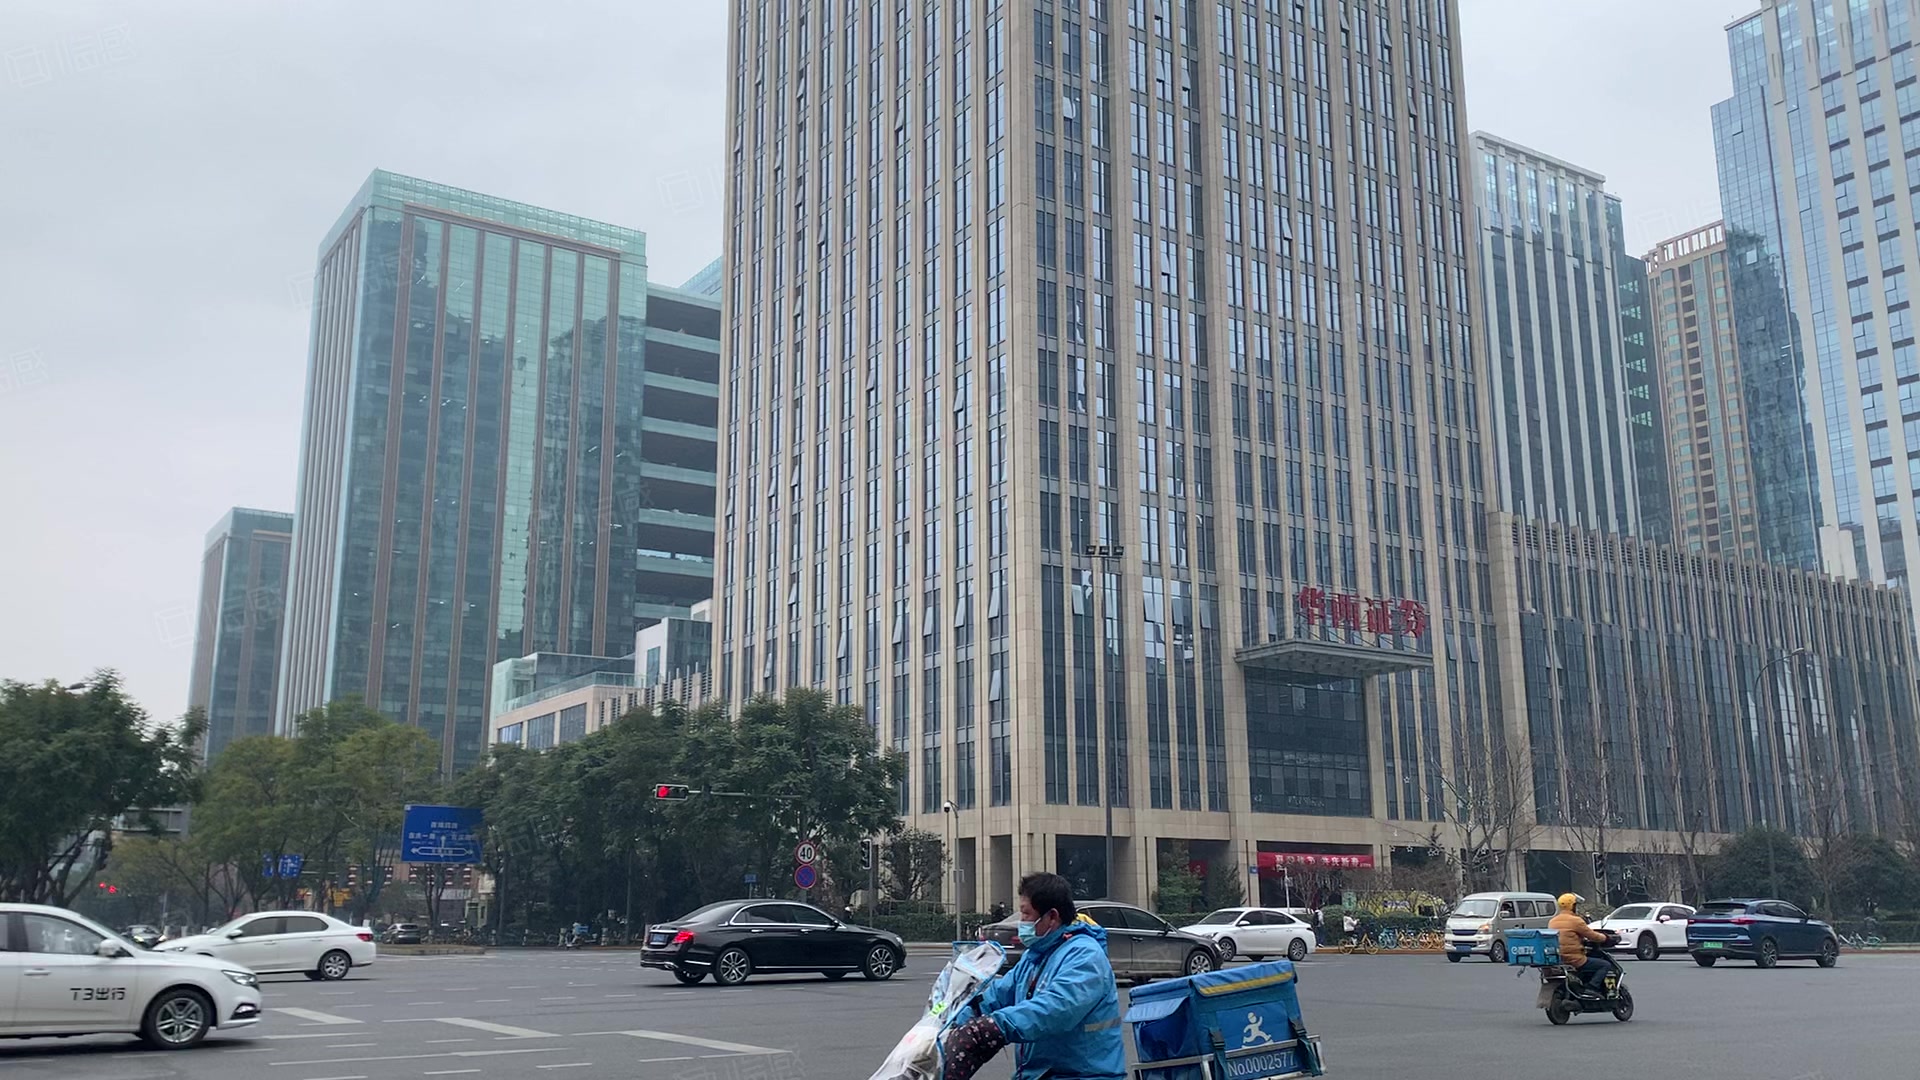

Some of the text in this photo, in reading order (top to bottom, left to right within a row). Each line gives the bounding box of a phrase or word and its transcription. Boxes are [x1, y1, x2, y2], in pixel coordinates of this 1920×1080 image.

[800, 847, 813, 860] 40
[69, 987, 126, 1001] T3出行
[1227, 1051, 1294, 1076] No.0002577
